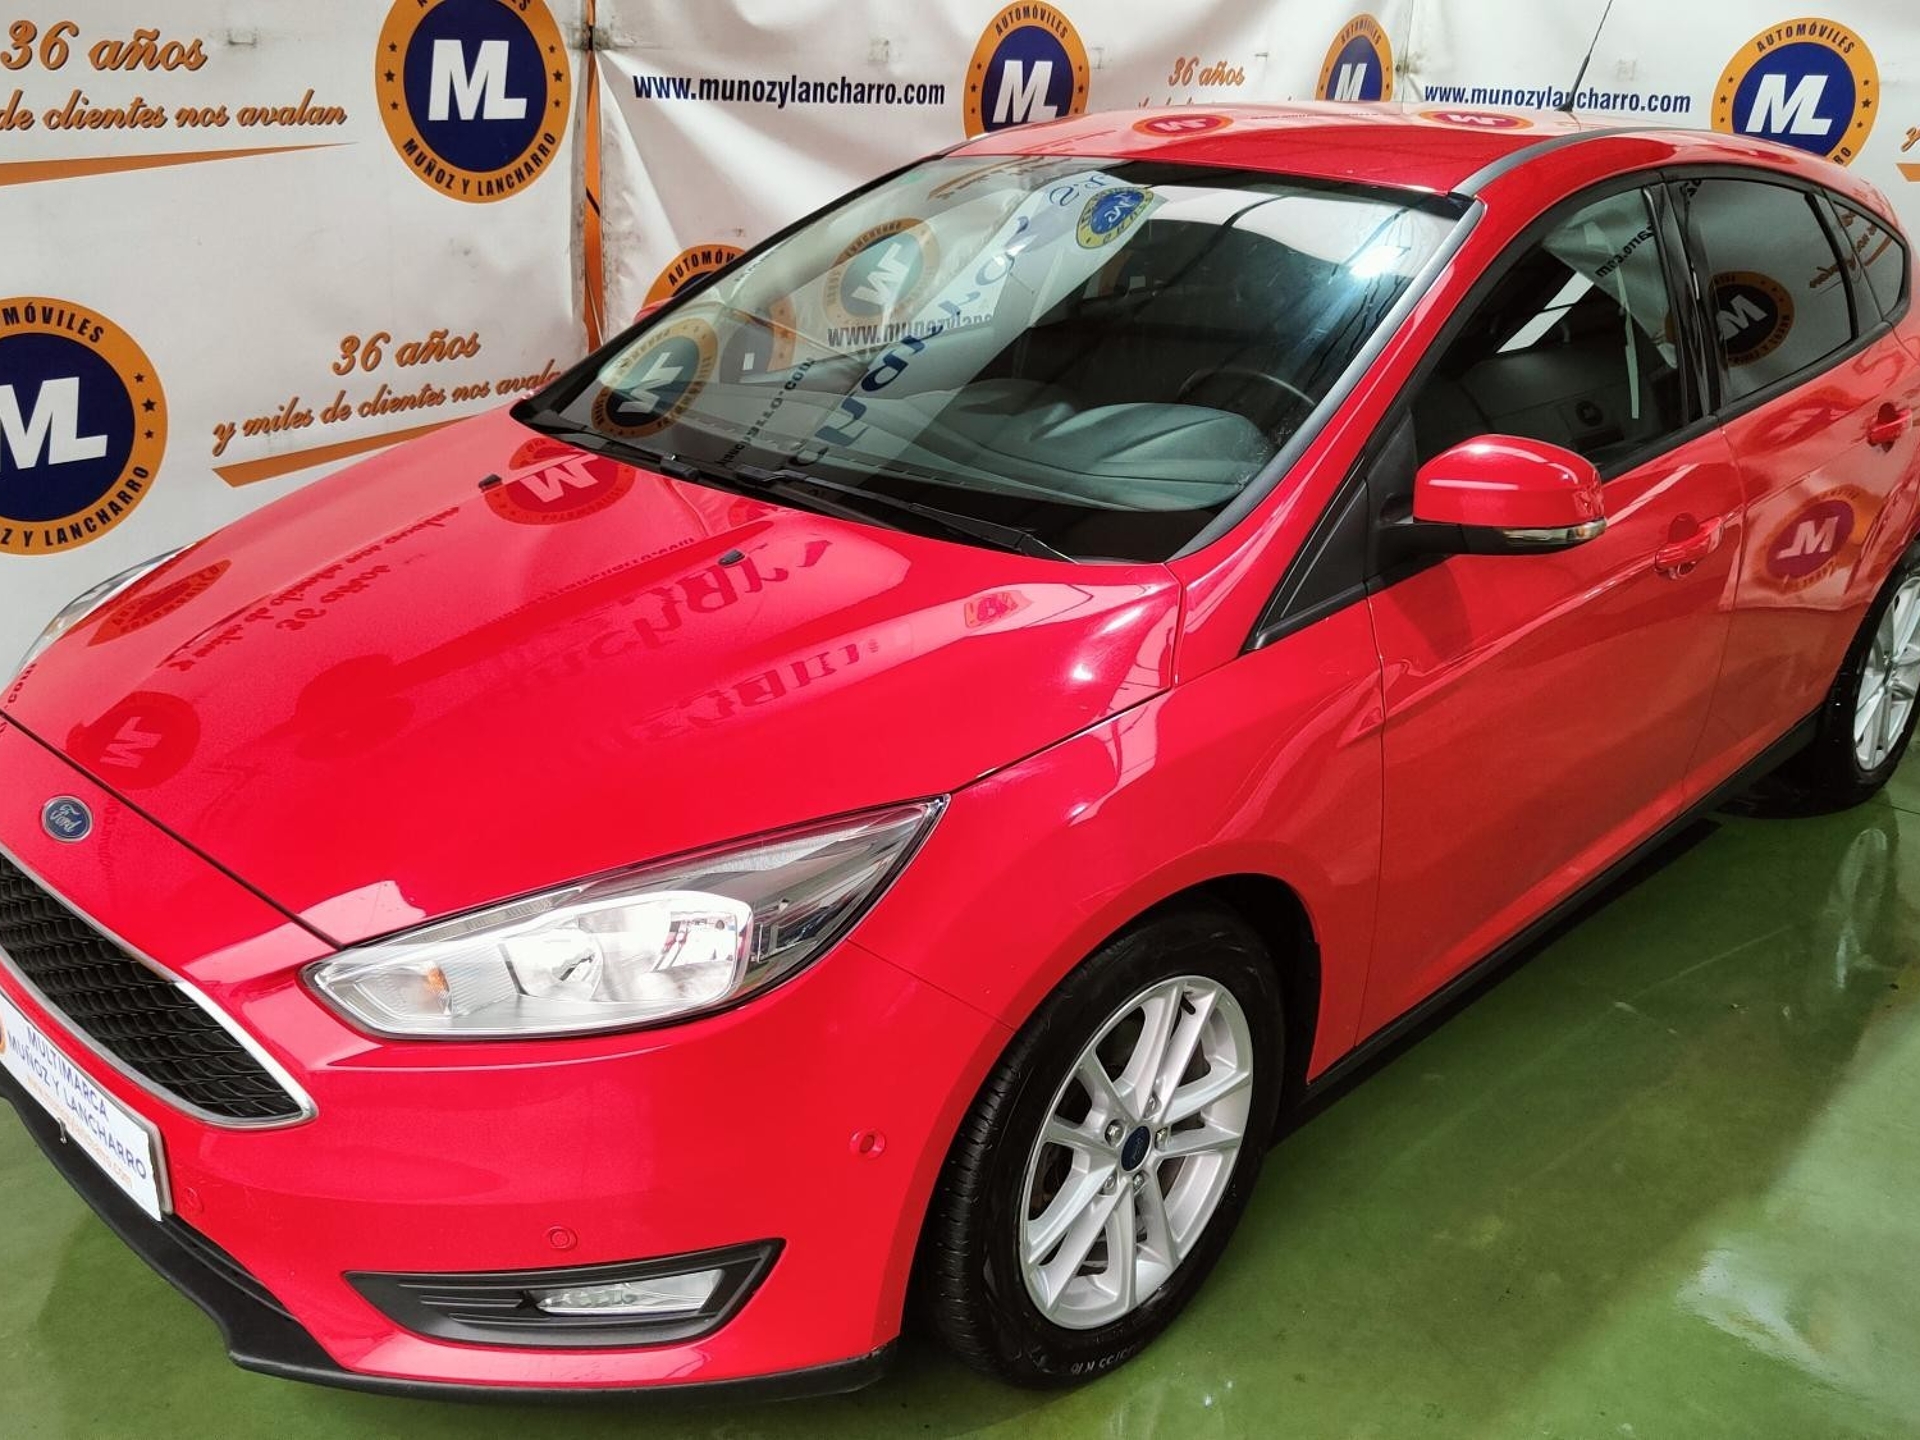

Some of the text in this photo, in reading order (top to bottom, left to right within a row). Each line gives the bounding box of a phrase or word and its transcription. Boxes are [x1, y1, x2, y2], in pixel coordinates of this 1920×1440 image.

[0, 20, 208, 71] 36 años
[995, 4, 1069, 39] AUTOMÓVILES
[1756, 21, 1855, 54] AUTOMÓVILES
[428, 39, 527, 121] ML
[632, 74, 946, 109] www.munozylancharro.com
[992, 60, 1058, 123] ML
[1167, 56, 1246, 87] 36 años
[43, 88, 168, 130] clientes
[174, 104, 229, 127] nos
[236, 88, 348, 127] avalan
[1745, 74, 1833, 136] ML
[403, 132, 556, 197] MUÑOZ Y LANCHARRO
[332, 328, 481, 376] 36 años
[212, 420, 236, 457] y
[242, 396, 314, 438] miles
[319, 389, 353, 425] de
[356, 383, 446, 416] clientes
[451, 382, 491, 402] nos
[23, 465, 149, 547] Y LANCHARRO
[8, 1031, 52, 1087] MUÑOZ
[52, 1077, 60, 1096] Y
[63, 1089, 147, 1180] LANCHARRO
[27, 1028, 109, 1122] MULTIMARCA
